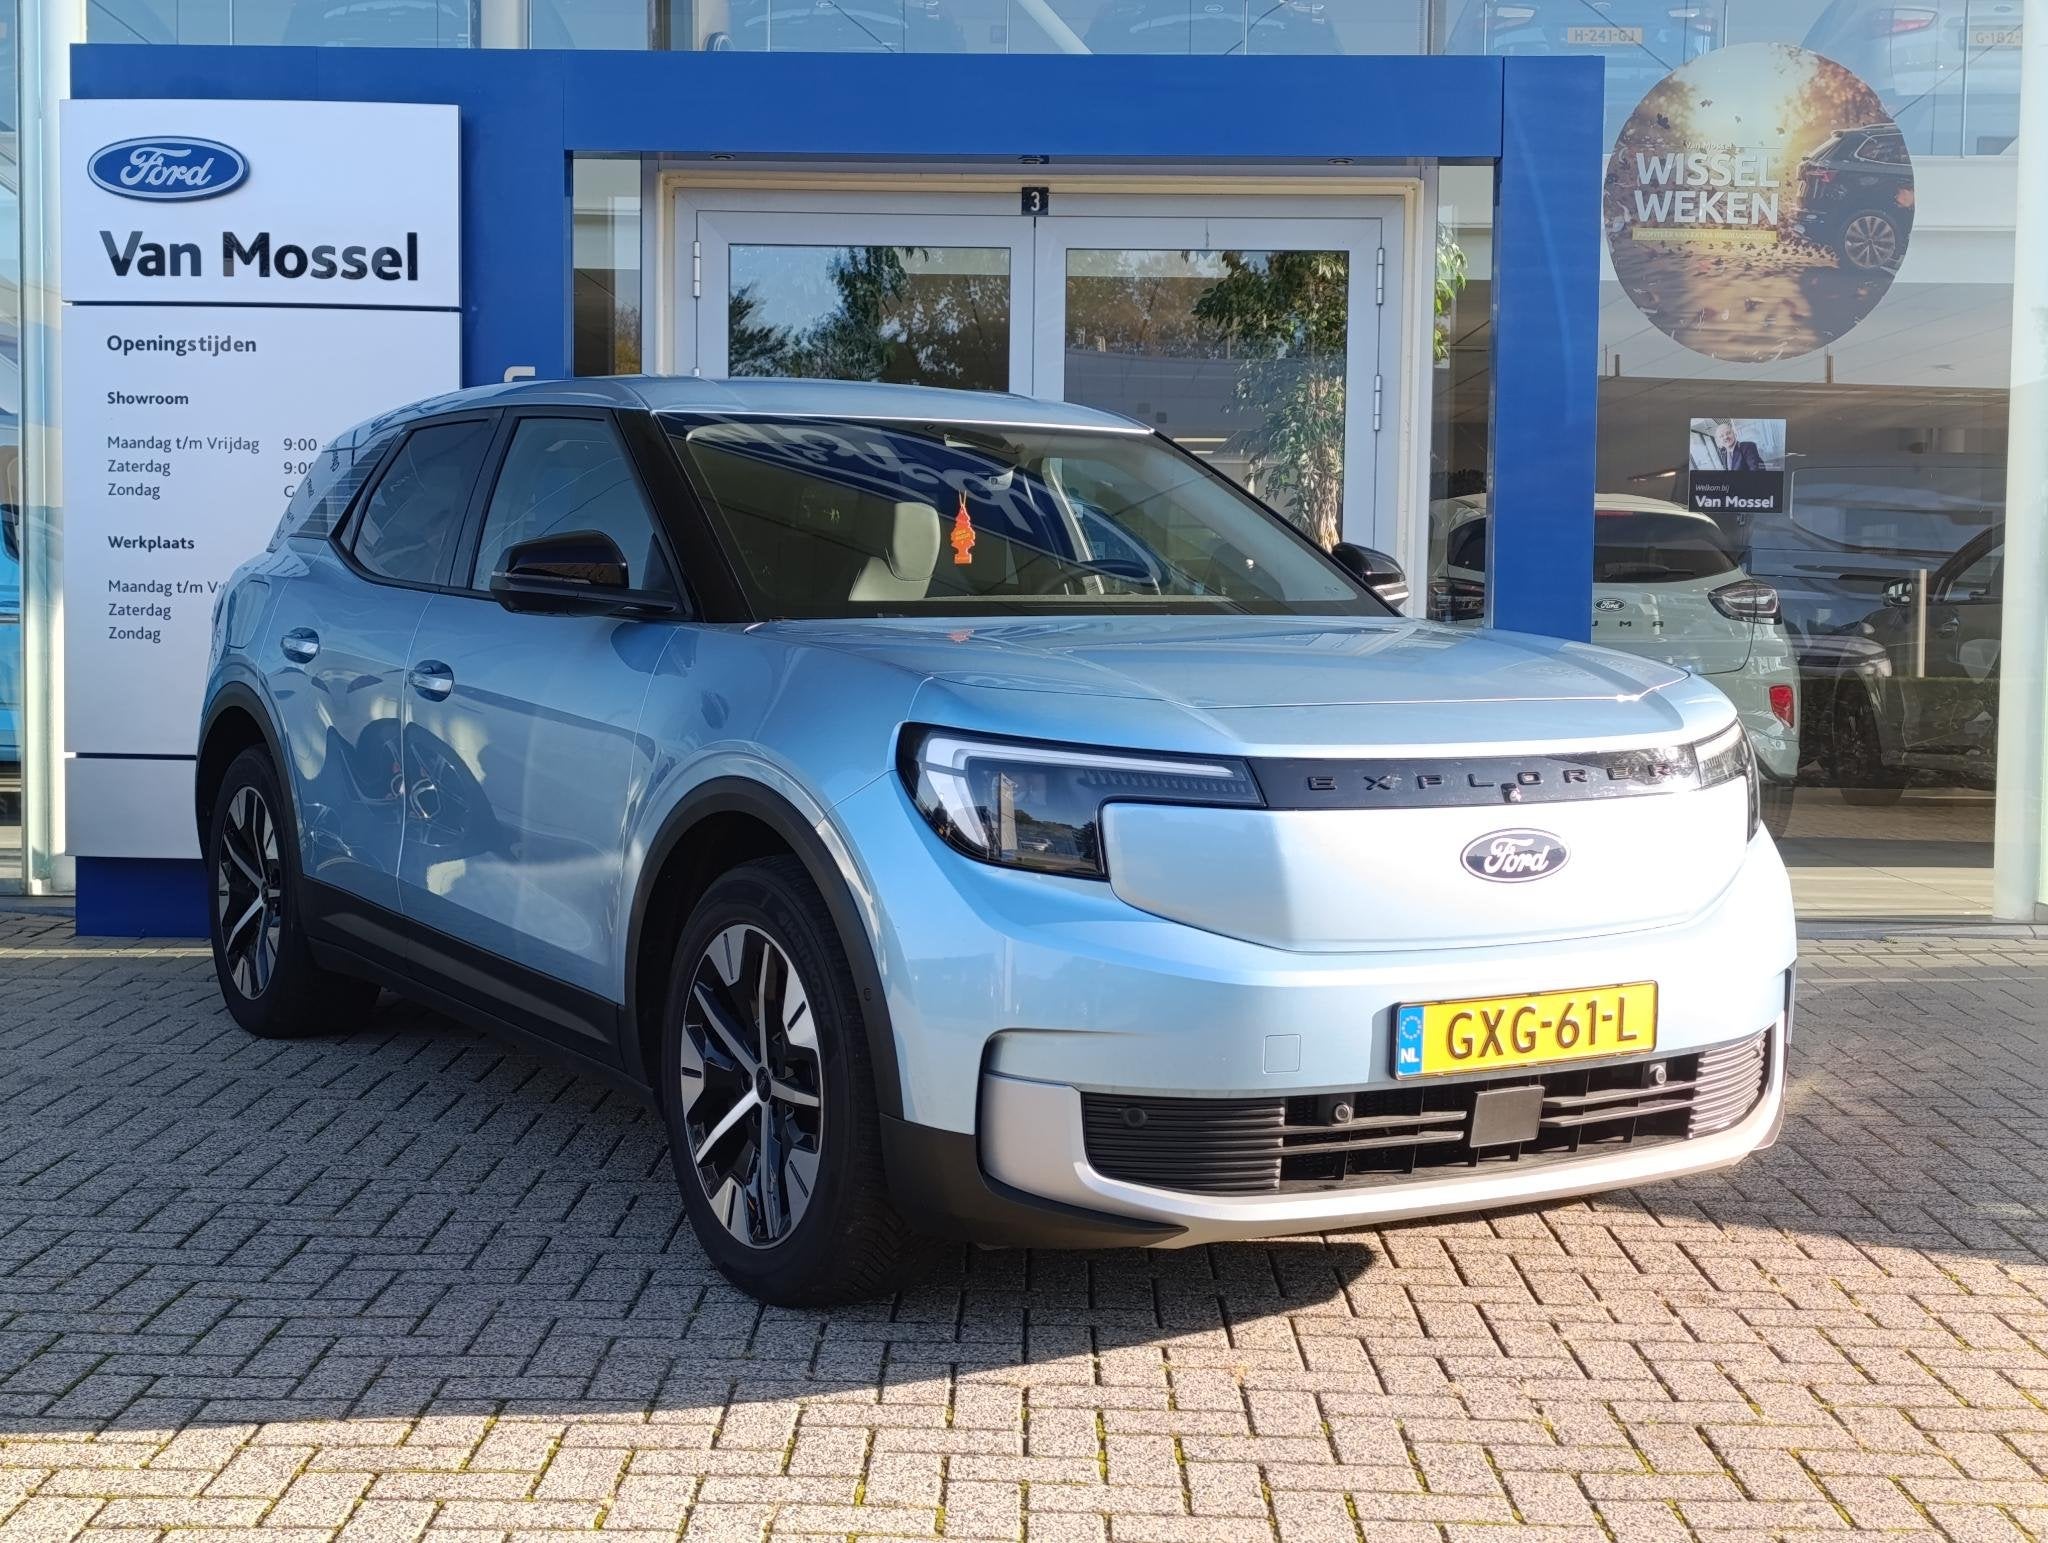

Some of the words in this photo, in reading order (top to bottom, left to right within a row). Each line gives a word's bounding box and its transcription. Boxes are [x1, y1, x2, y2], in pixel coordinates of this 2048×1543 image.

[119, 146, 214, 187] Ford
[1636, 152, 1779, 187] WISSEL
[1030, 191, 1040, 211] 3
[1634, 190, 1778, 225] WEKEN
[99, 231, 202, 277] Van
[223, 232, 418, 281] Mossel
[107, 335, 257, 357] Openingstijden
[107, 391, 189, 405] Showroom
[107, 436, 172, 453] Maandag
[176, 436, 203, 450] t/m
[207, 437, 260, 454] Vrijdag
[283, 438, 317, 451] 9:00
[107, 459, 171, 476] Zaterdag
[283, 461, 313, 475] 9:0
[107, 483, 161, 500] Zondag
[1695, 484, 1720, 492] Welkom
[1695, 495, 1721, 508] Van
[1725, 495, 1774, 508] Mossel
[107, 536, 195, 550] Werkplaats
[108, 579, 172, 597] Maandag
[176, 580, 203, 594] t/m
[108, 602, 172, 620] Zaterdag
[108, 626, 161, 643] Zondag
[1307, 764, 1672, 792] EXPLORER
[1484, 837, 1550, 873] Ford
[1400, 1047, 1420, 1064] NL
[1446, 997, 1638, 1060] GXG-61-L
